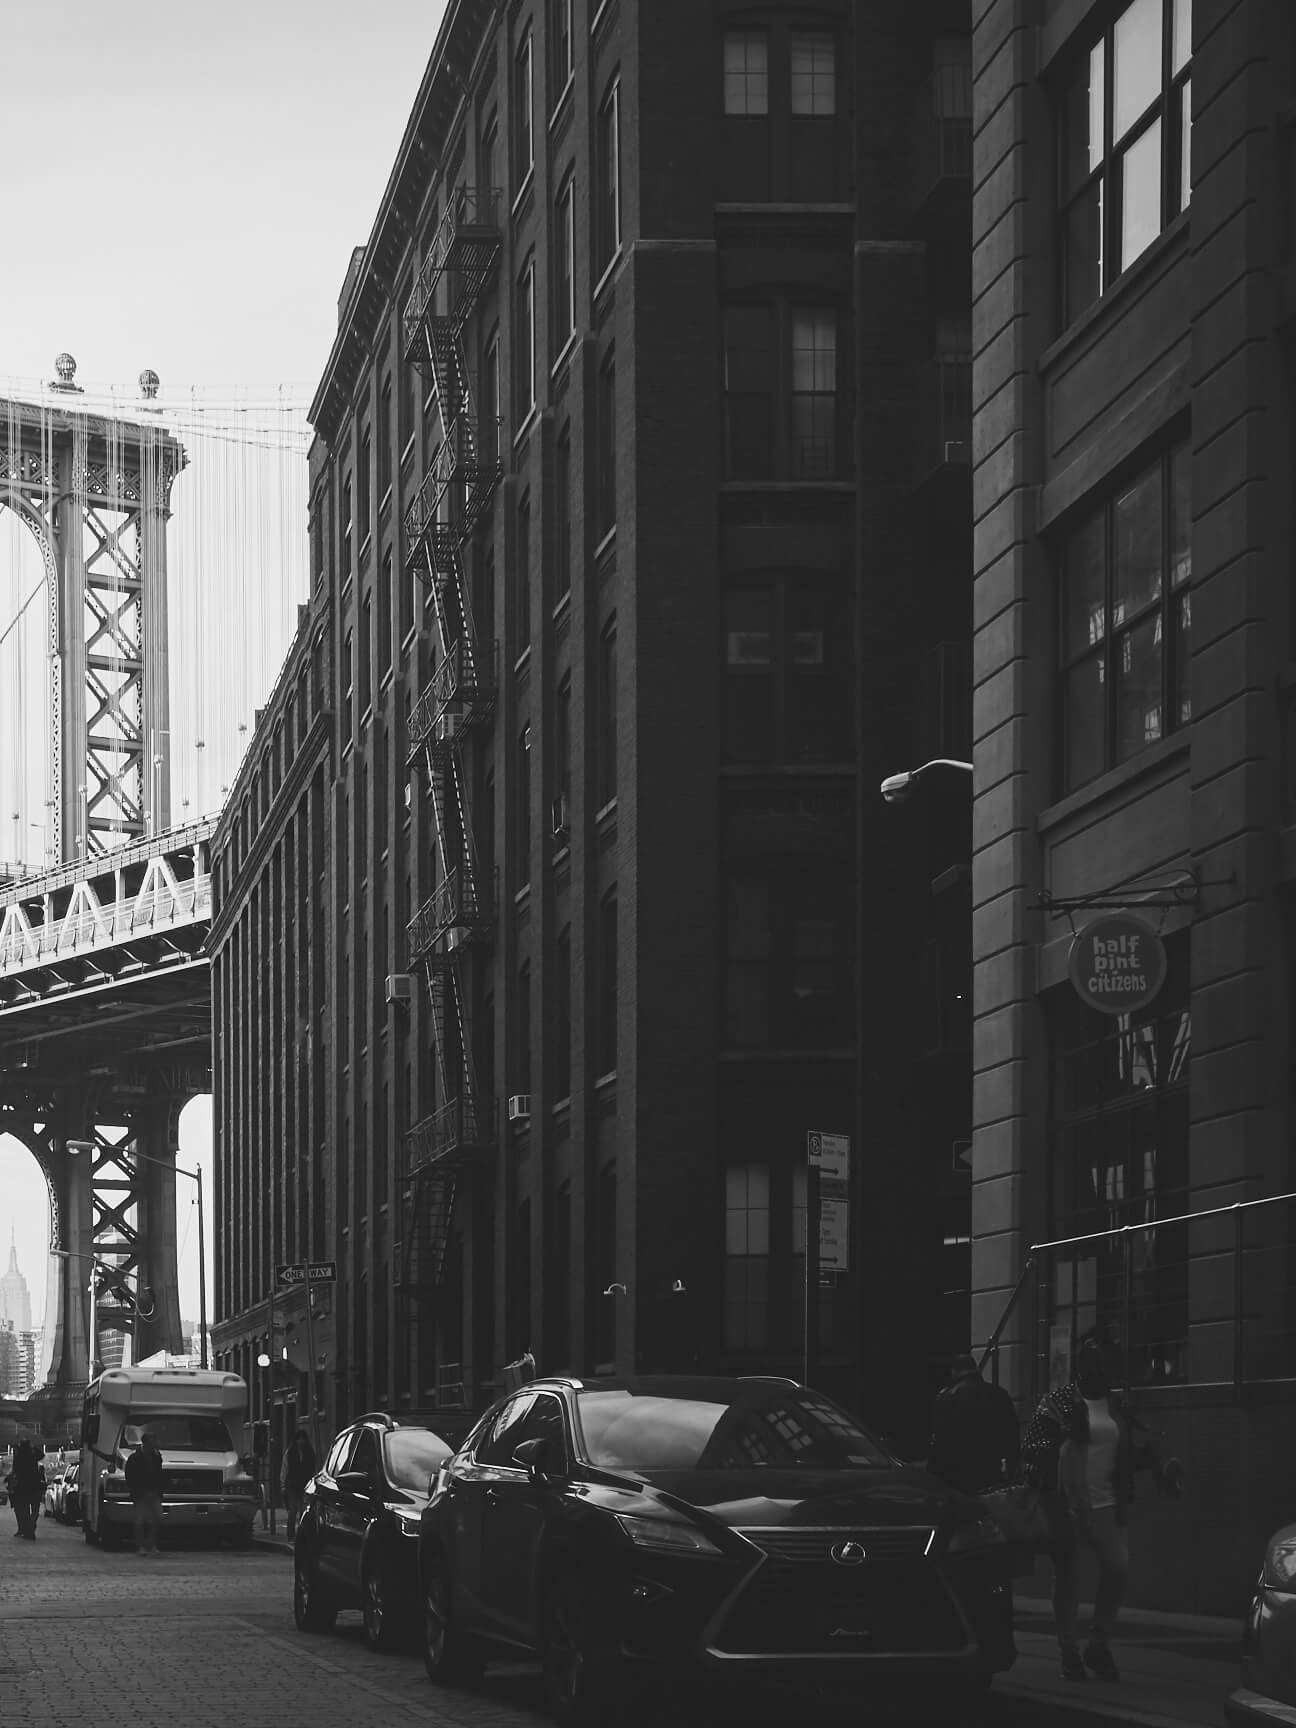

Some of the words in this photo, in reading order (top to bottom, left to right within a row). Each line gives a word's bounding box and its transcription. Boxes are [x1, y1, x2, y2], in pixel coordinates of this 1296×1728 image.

[1092, 935, 1140, 955] half
[1094, 953, 1141, 973] pint
[1088, 970, 1147, 993] citizens
[285, 1270, 303, 1280] ONE
[310, 1268, 328, 1278] WAY
